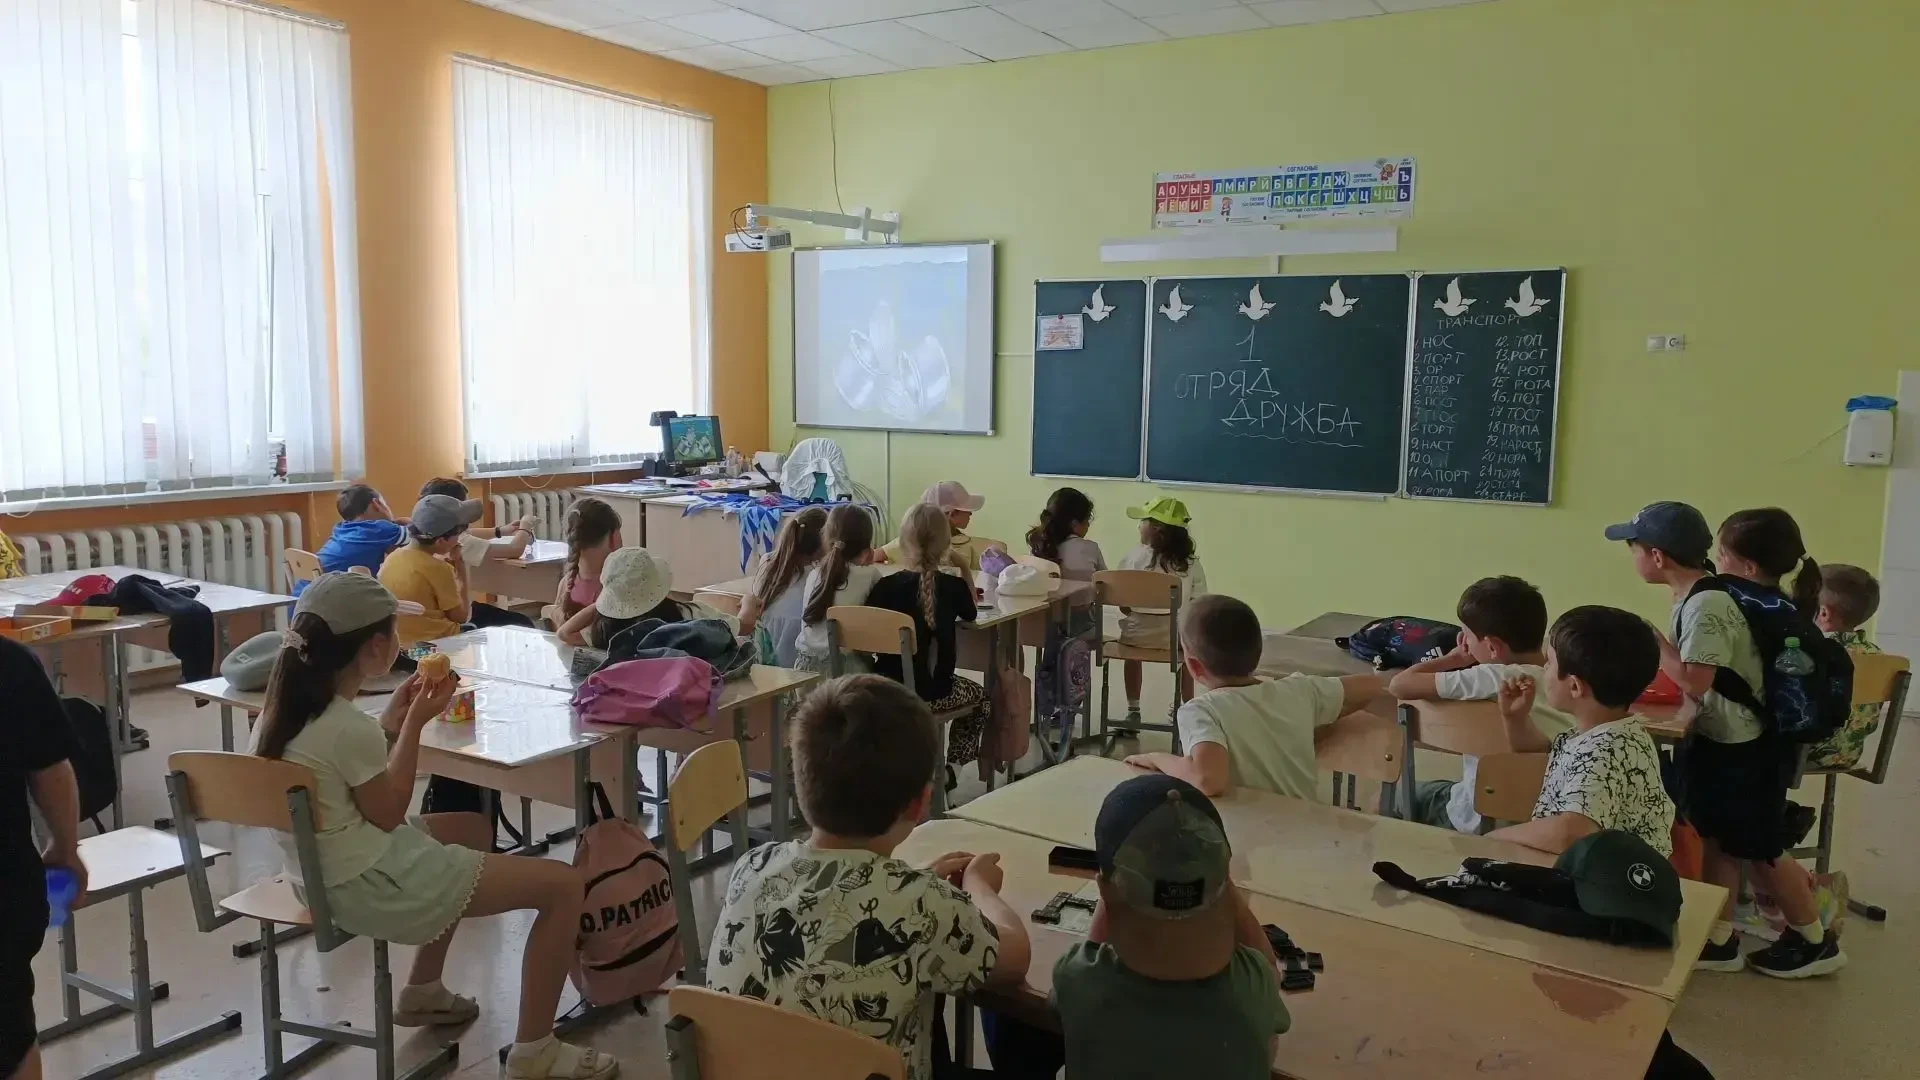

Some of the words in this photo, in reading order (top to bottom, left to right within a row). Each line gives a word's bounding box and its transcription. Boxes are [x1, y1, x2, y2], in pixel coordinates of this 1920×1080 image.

[1437, 314, 1521, 329] ТРАНСПОРТ
[1236, 324, 1262, 362] 1
[1423, 334, 1455, 349] НОС
[1515, 334, 1543, 347] ТОП
[1423, 352, 1465, 364] ПОРТ
[1510, 349, 1549, 361] РОСТ
[1518, 365, 1549, 376] РОТ
[1175, 367, 1280, 399] ОТРЯД
[1422, 374, 1465, 385] СПОРТ
[1514, 379, 1552, 390] РОТА
[1513, 393, 1543, 405] ПОТ
[1221, 398, 1362, 437] ДРУЖБА
[1508, 407, 1544, 422] ТОСТ
[1421, 424, 1457, 436] ТОРТ
[1501, 422, 1540, 437] ТРОПА
[1421, 440, 1456, 452] НАСТ
